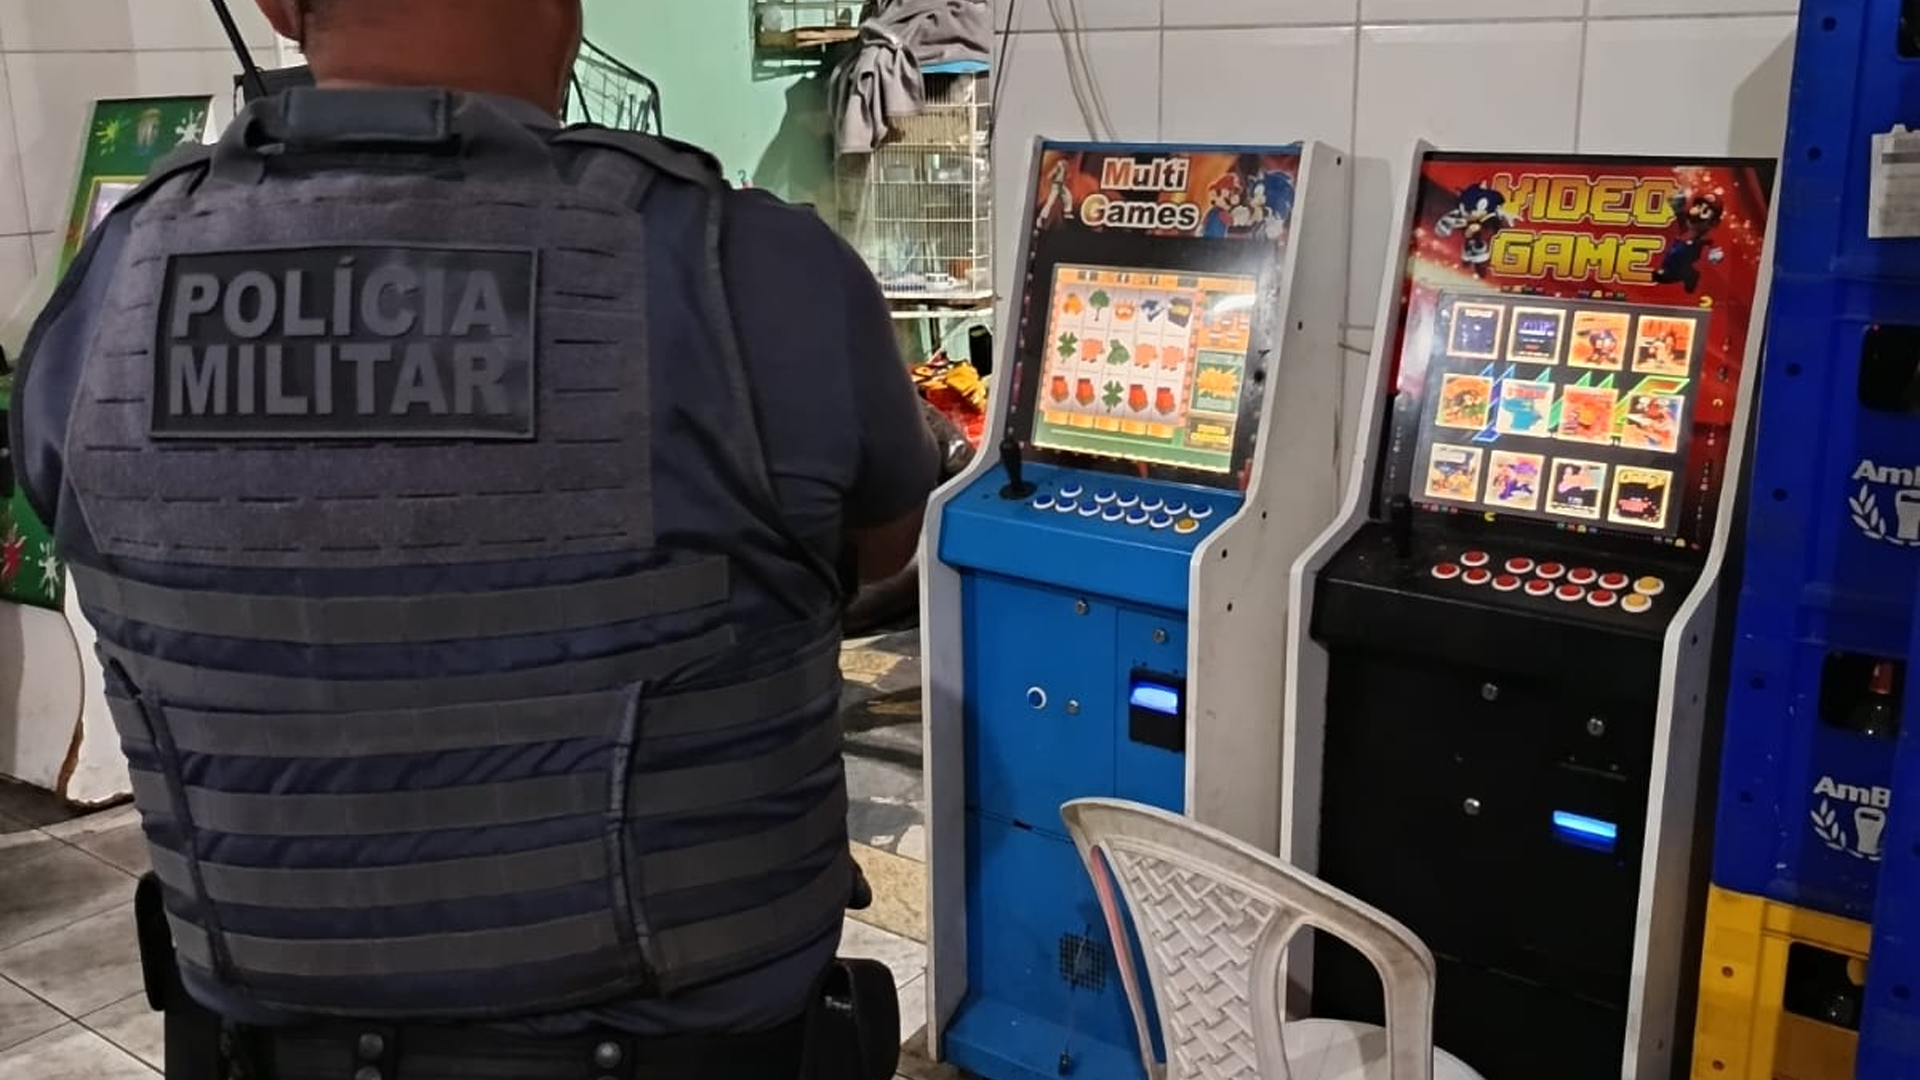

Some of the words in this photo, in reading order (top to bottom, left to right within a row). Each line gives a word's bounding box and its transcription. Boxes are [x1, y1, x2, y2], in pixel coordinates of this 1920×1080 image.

[1101, 158, 1189, 191] Multi
[1495, 175, 1680, 226] VIDEO
[1081, 194, 1200, 230] Games
[1491, 230, 1665, 285] GAME
[170, 256, 512, 338] POLÍCIA
[168, 342, 512, 416] MILITAR
